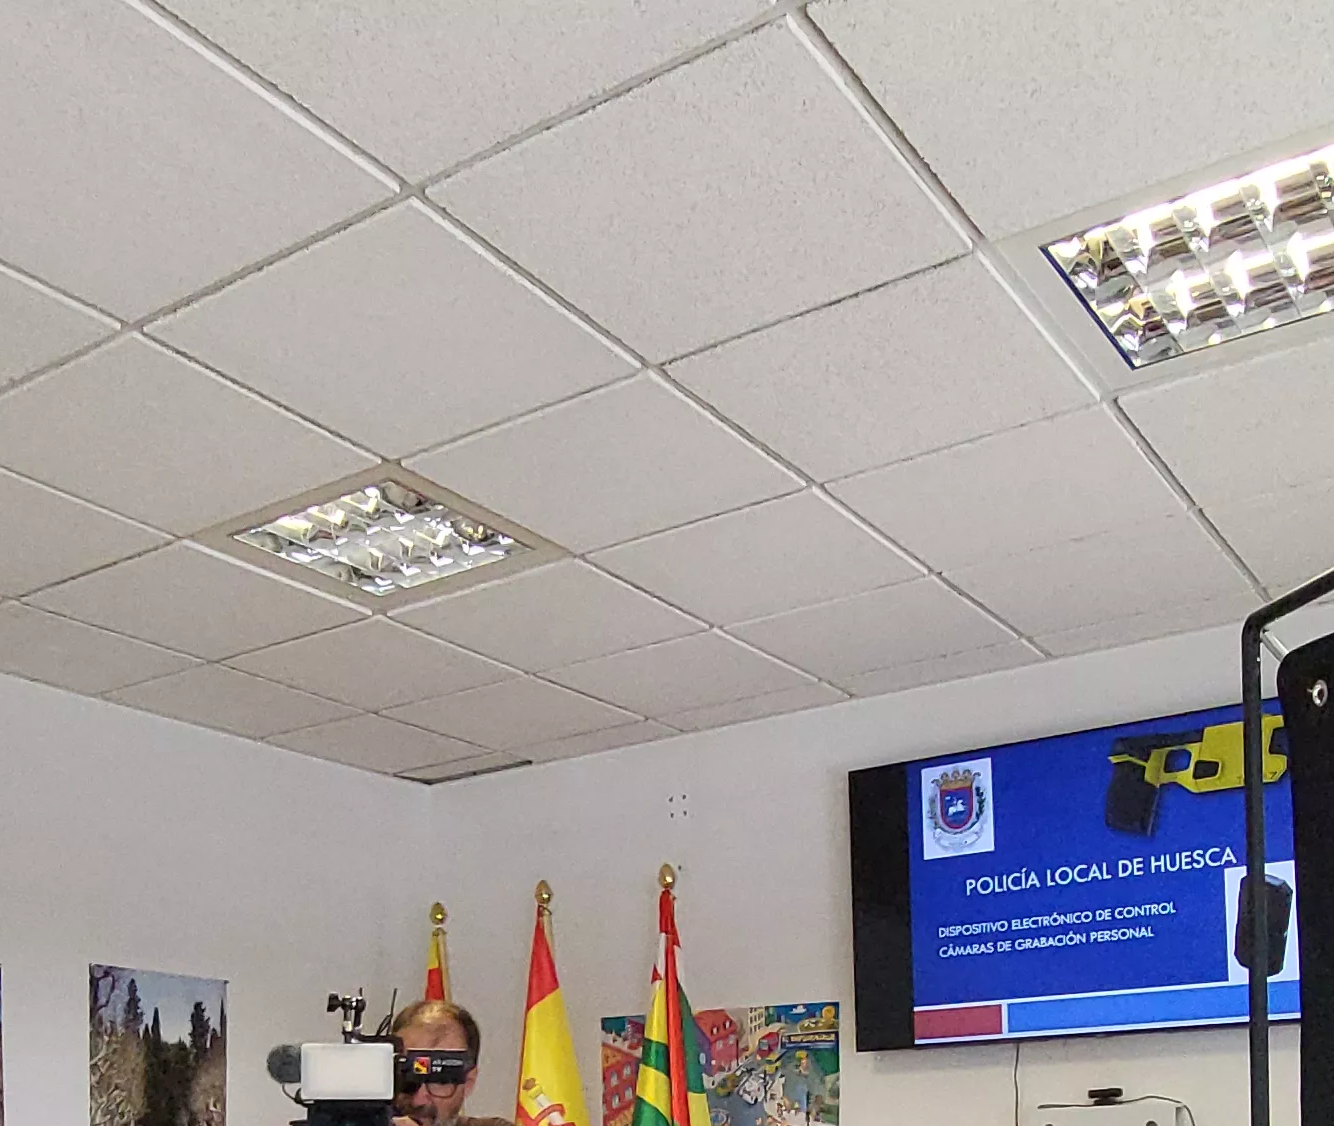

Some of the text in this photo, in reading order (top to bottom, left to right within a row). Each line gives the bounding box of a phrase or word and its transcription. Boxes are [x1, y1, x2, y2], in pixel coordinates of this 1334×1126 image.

[965, 846, 1238, 896] POLICÍA LOCAL DE HUESCA
[938, 901, 1177, 938] DISPOSITIVO ELECTRÓNICO DE CONTROL
[938, 926, 1155, 958] CÁMARAS DE GRABACIÓN PERSONAL
